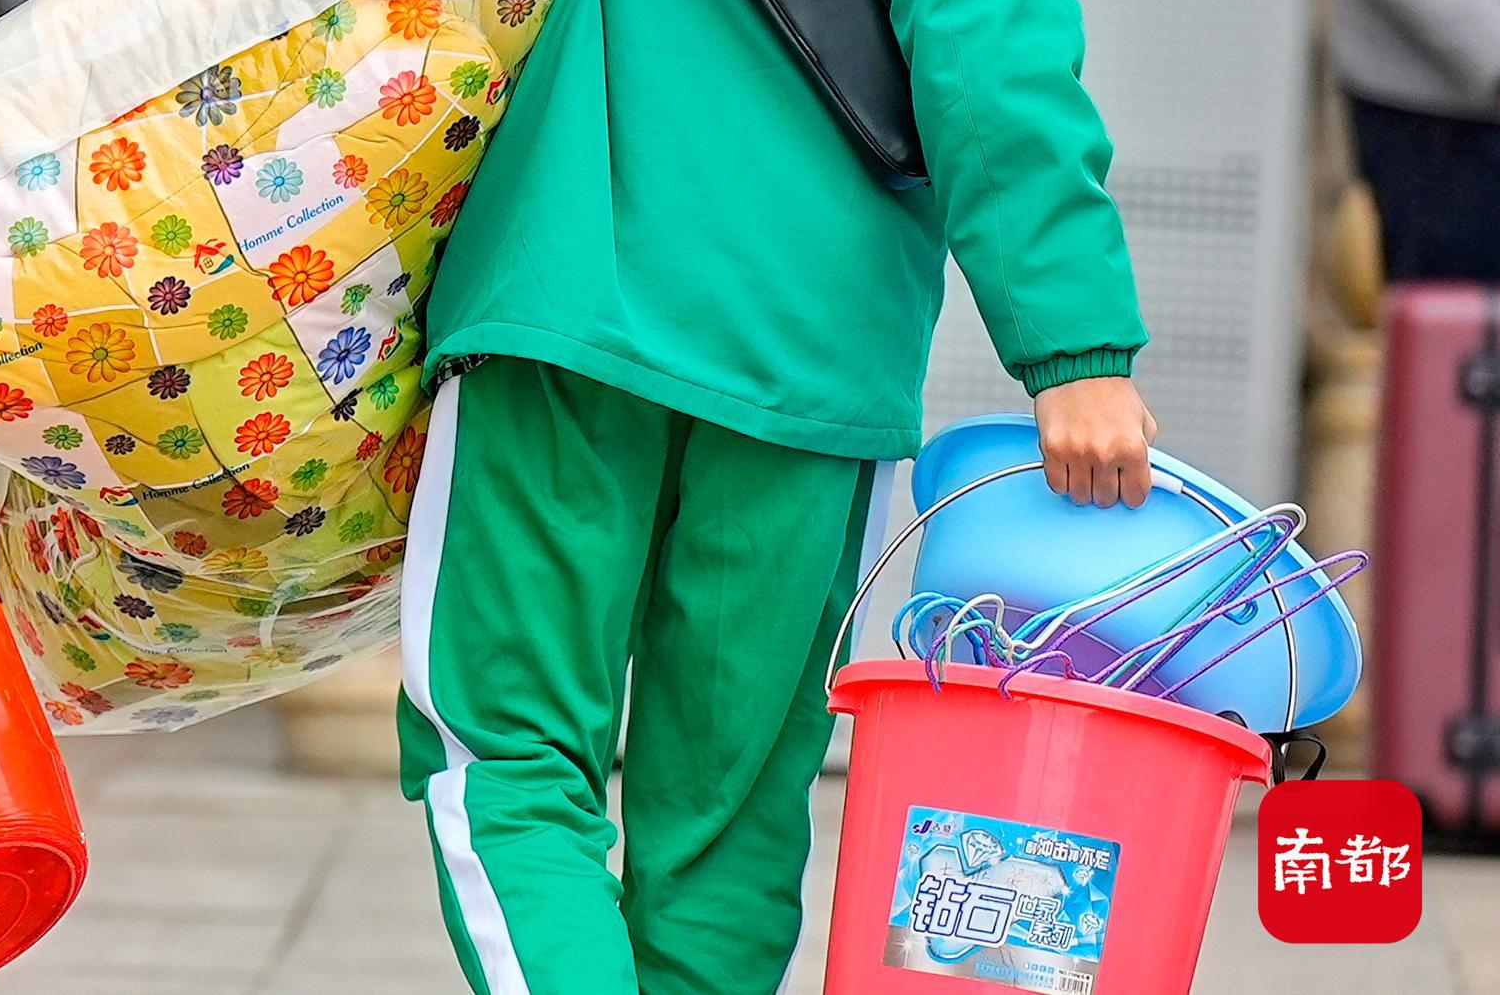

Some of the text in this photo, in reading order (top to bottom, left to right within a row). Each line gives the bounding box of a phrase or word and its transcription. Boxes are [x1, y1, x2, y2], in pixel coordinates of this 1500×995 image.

[239, 194, 344, 252] Homme Collection
[142, 484, 190, 500] Homme
[911, 874, 1017, 946] 钻石
[1016, 893, 1060, 922] 世家
[1028, 921, 1074, 949] 系列
